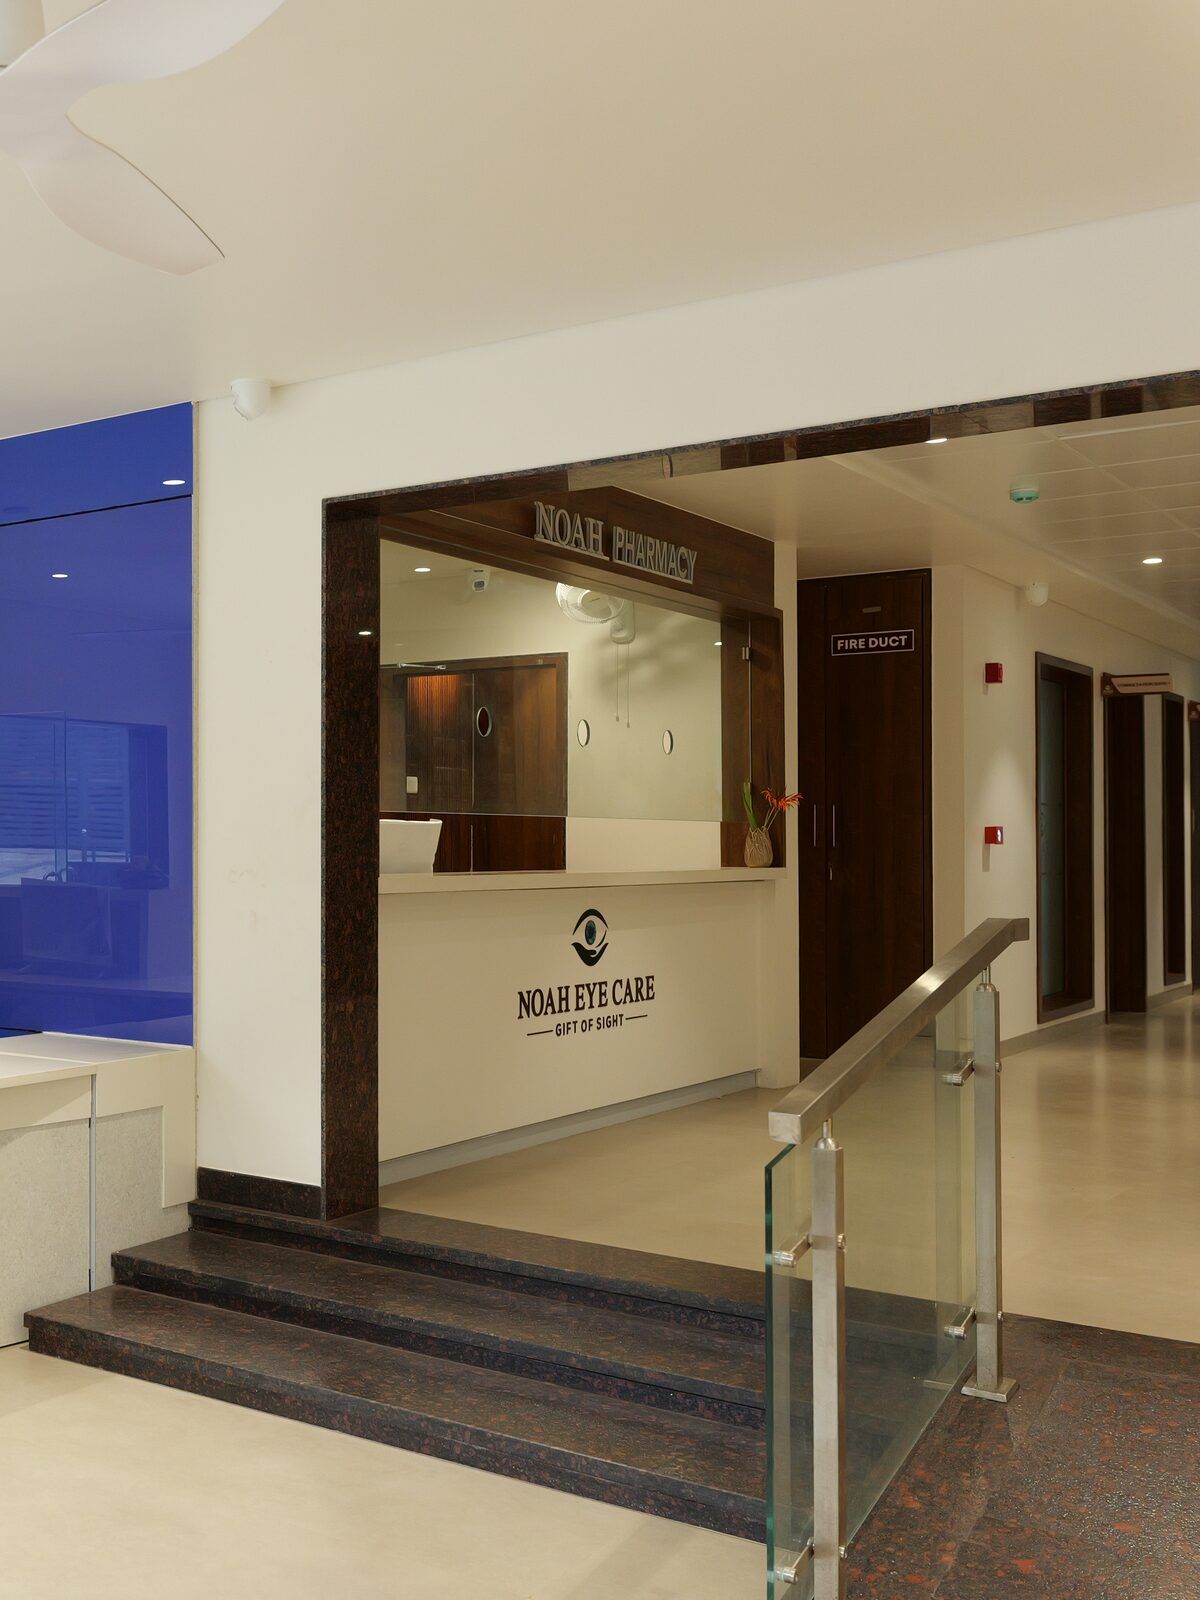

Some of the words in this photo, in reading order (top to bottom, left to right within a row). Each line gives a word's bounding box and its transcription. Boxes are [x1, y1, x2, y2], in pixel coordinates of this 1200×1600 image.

[534, 501, 609, 561] NOAH
[613, 526, 697, 585] PHARMACY
[837, 638, 866, 651] FIRE
[868, 635, 908, 649] DUCT
[517, 985, 571, 1020] NOAH
[574, 980, 609, 1012] EYE
[611, 975, 656, 1006] CARE
[555, 1020, 578, 1037] GIFT
[580, 1018, 594, 1033] OF
[596, 1013, 625, 1030] SIGHT
